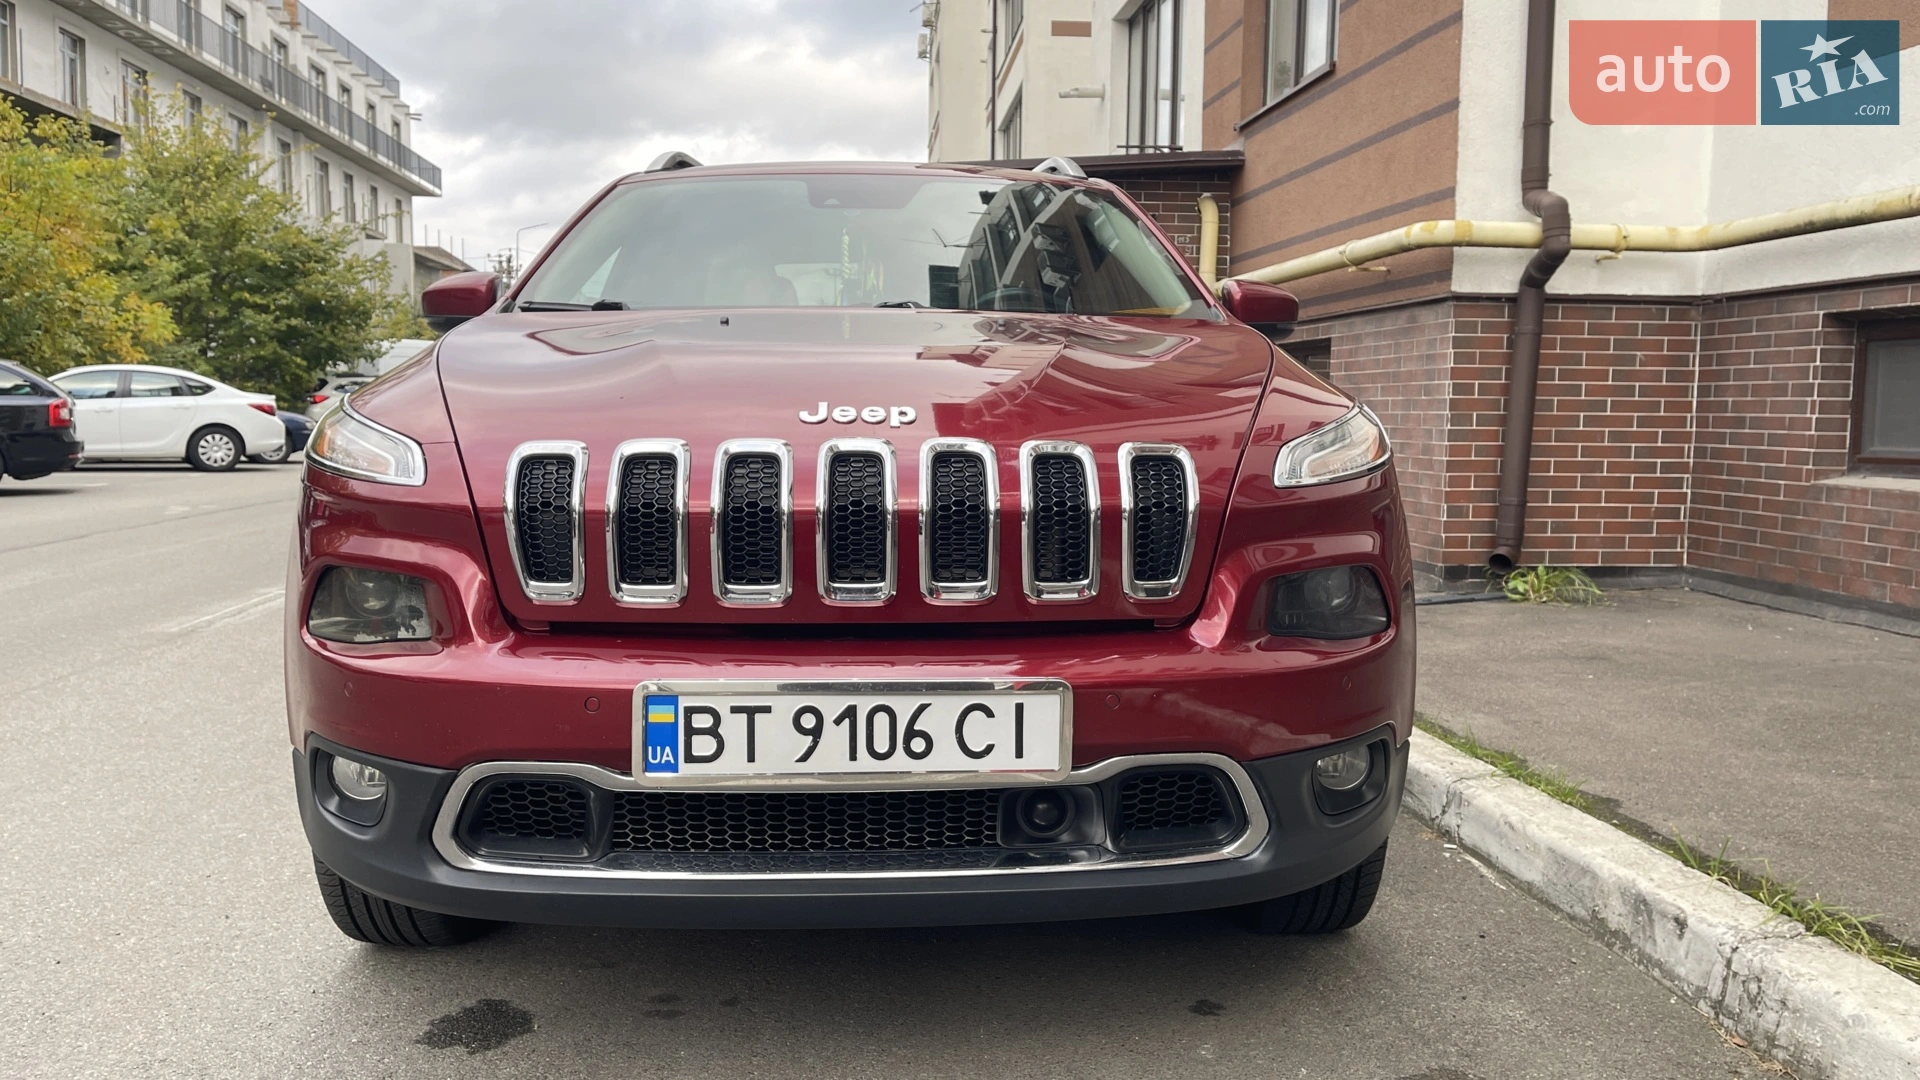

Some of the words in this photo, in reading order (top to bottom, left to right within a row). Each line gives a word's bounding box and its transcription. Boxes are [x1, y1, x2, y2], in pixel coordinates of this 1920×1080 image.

[799, 401, 917, 428] Jeep
[682, 705, 773, 764] BT
[792, 702, 934, 763] 9106
[954, 702, 1025, 760] CI
[648, 745, 675, 765] UA
